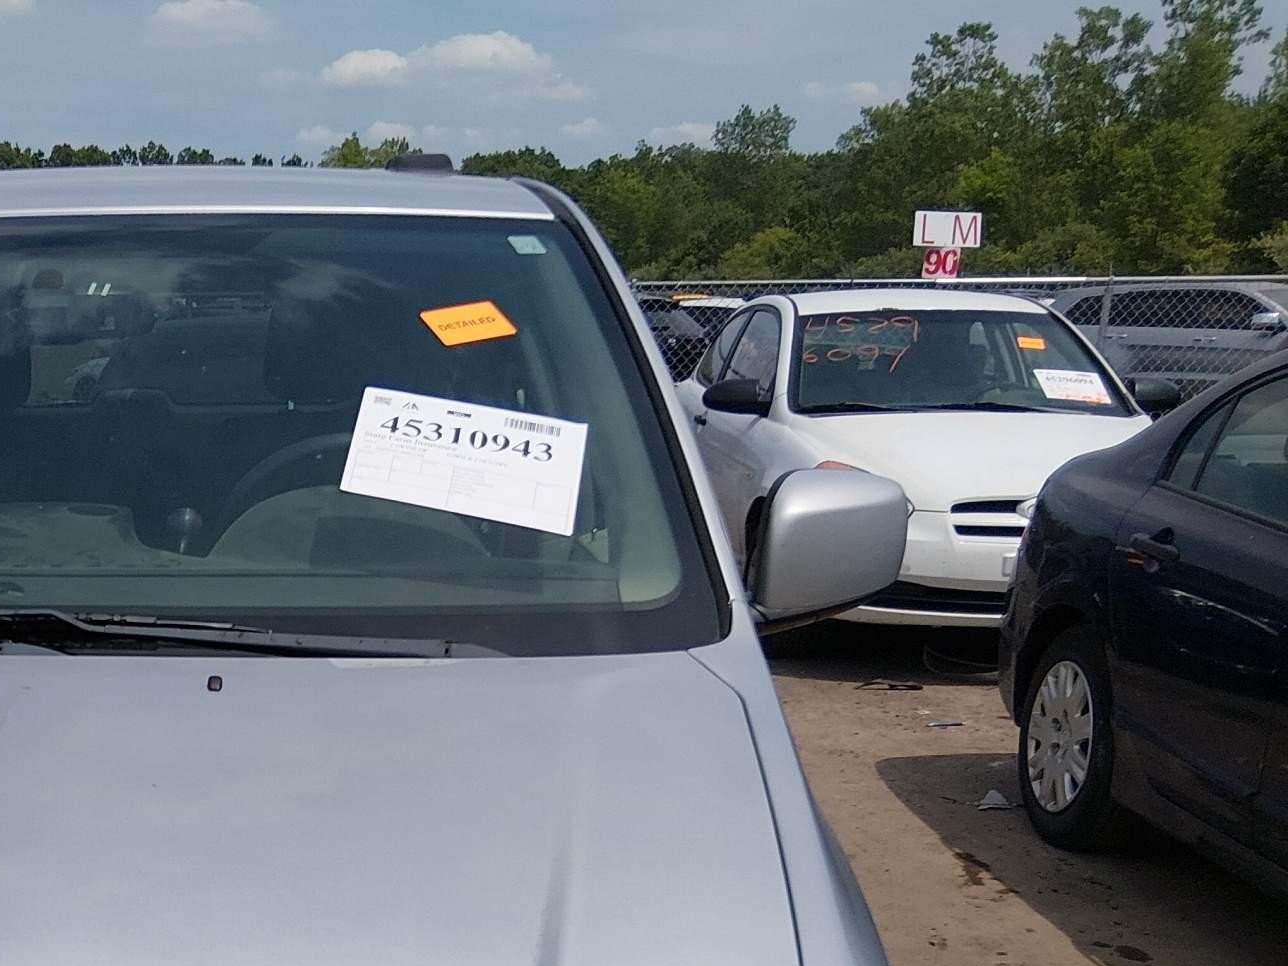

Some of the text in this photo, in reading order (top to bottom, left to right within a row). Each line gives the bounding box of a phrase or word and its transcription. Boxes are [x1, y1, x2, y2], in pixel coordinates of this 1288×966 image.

[921, 214, 978, 246] L M
[924, 248, 959, 276] 90
[438, 316, 497, 332] DETAILED
[380, 416, 553, 462] 45310943
